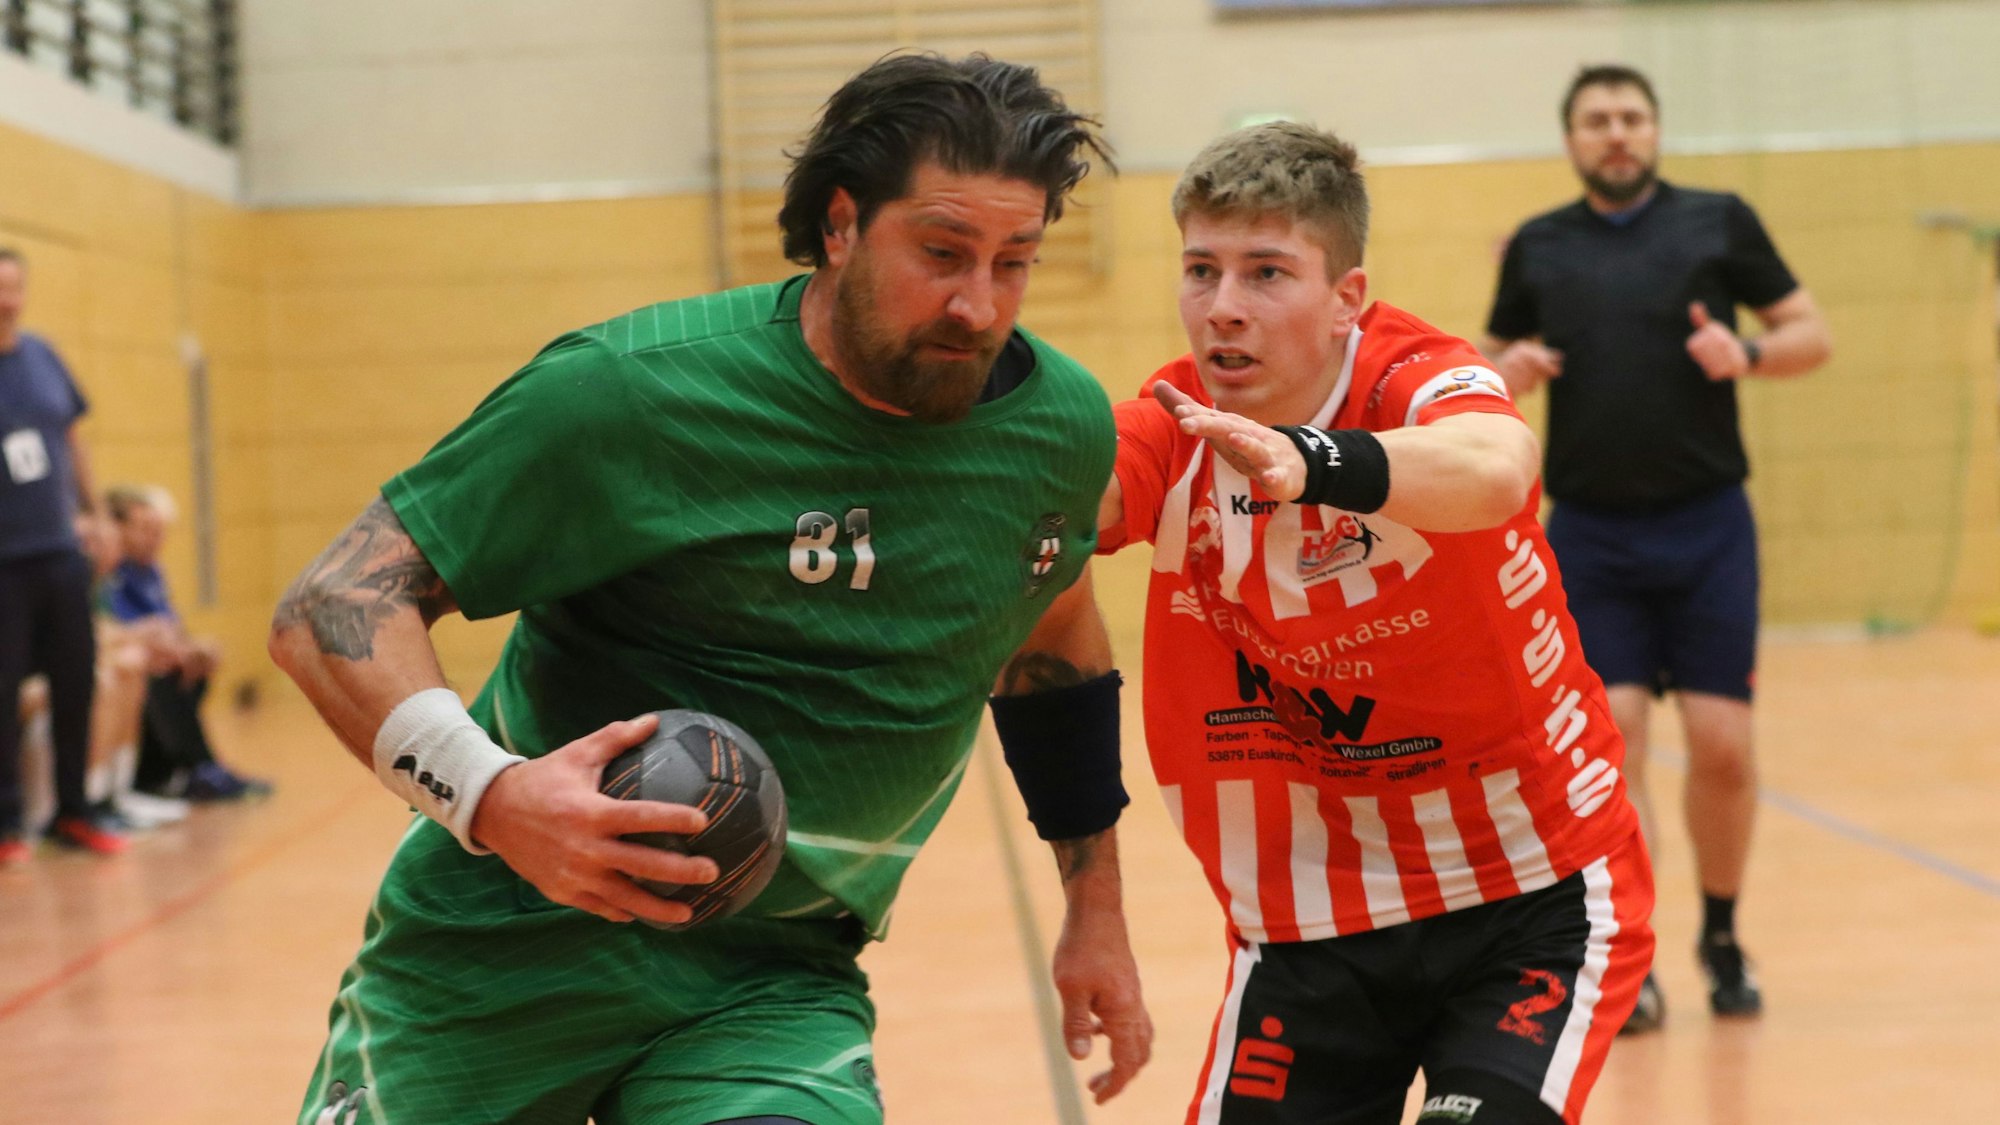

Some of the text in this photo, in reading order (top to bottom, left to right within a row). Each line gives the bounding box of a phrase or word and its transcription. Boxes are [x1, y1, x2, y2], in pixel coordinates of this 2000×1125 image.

[788, 507, 876, 592] 81
[1206, 730, 1250, 743] Farben
[1207, 750, 1244, 762] 53879
[1341, 745, 1386, 760] Wexel
[1389, 738, 1435, 755] GmbH
[1497, 968, 1567, 1046] 2
